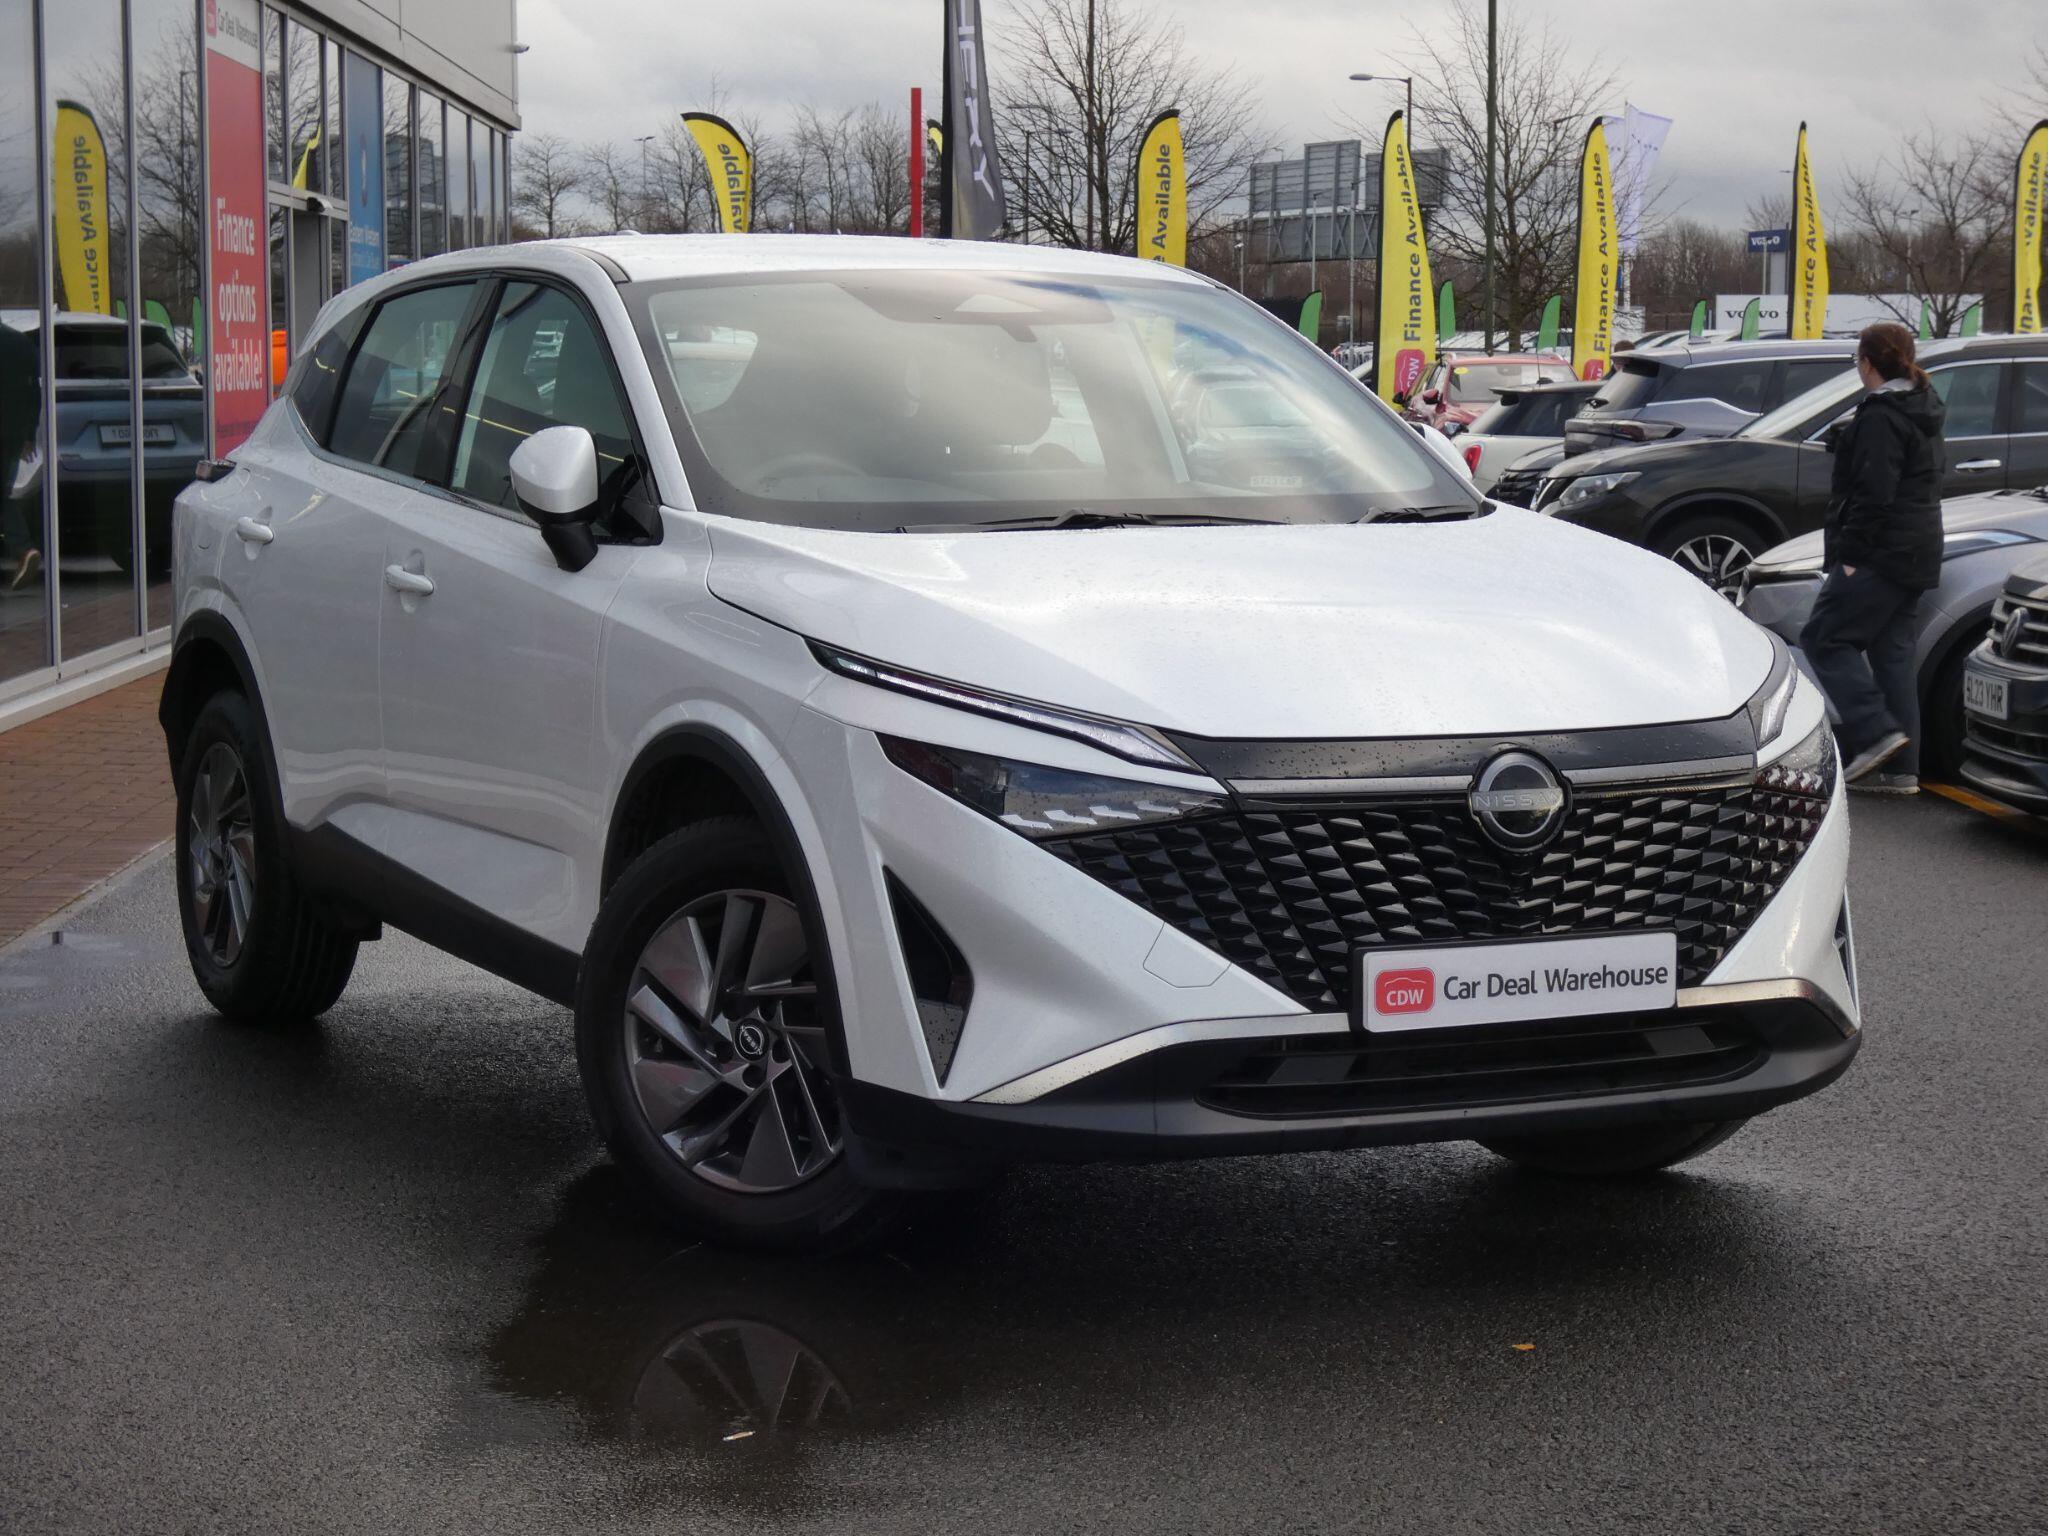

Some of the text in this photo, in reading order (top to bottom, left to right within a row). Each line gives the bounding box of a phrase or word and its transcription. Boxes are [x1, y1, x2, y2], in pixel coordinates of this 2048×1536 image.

[217, 197, 255, 257] Finance
[1151, 144, 1171, 250] Available
[1593, 152, 1608, 257] Available
[2023, 152, 2040, 247] vailable
[1396, 143, 1422, 342] Finance Available
[218, 269, 257, 338] options
[1593, 263, 1608, 352] Finance
[1725, 310, 1779, 319] VOVO
[214, 339, 263, 393] available!
[1475, 790, 1561, 807] NISSAN
[1386, 988, 1425, 1007] CDW
[1443, 964, 1669, 1001] Car Deal Warehouse
